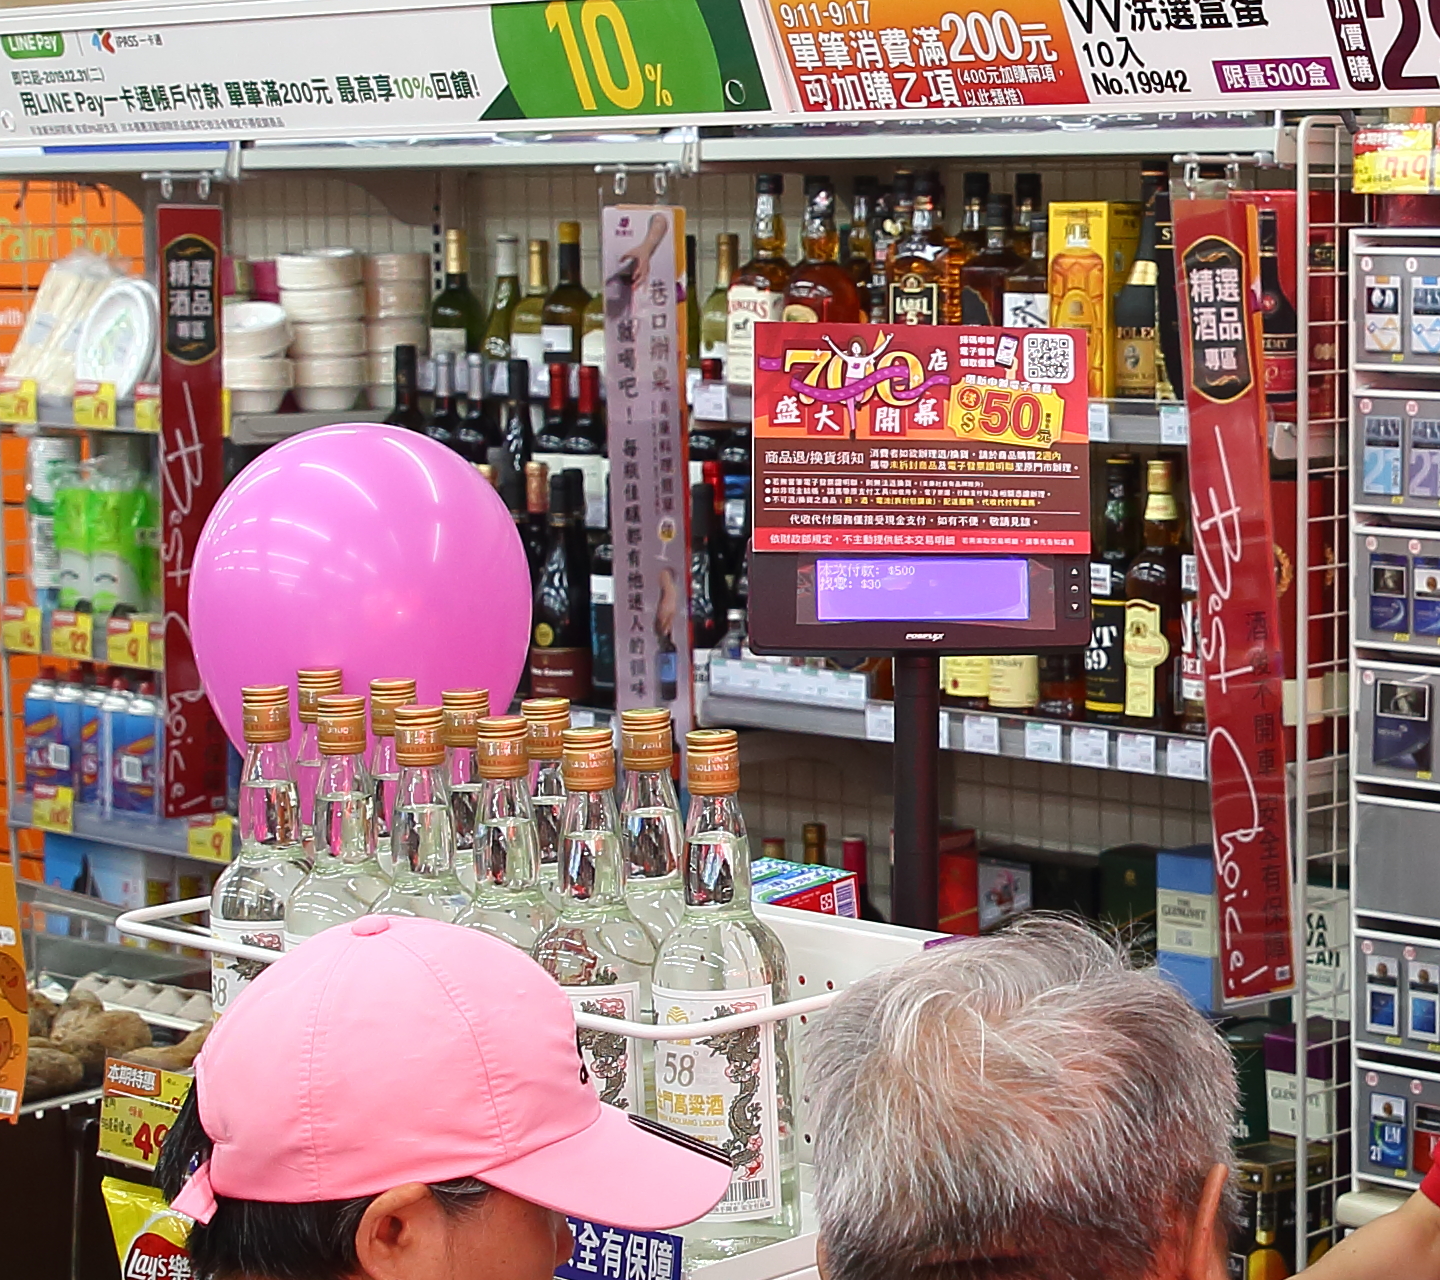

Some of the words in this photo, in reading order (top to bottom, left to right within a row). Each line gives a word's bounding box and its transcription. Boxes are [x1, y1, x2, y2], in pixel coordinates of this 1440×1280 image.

[779, 0, 870, 26] 9/11-9/17
[9, 35, 35, 52] LINE
[37, 34, 58, 54] Pay
[787, 11, 1057, 71] 單筆消費滿200元
[1083, 40, 1140, 69] 10入
[802, 68, 961, 112] 可加購乙項
[1092, 70, 1191, 97] No.19942
[1222, 61, 1330, 92] 限量500盒
[773, 396, 940, 434] 盛大開幕
[980, 392, 1042, 437] 50
